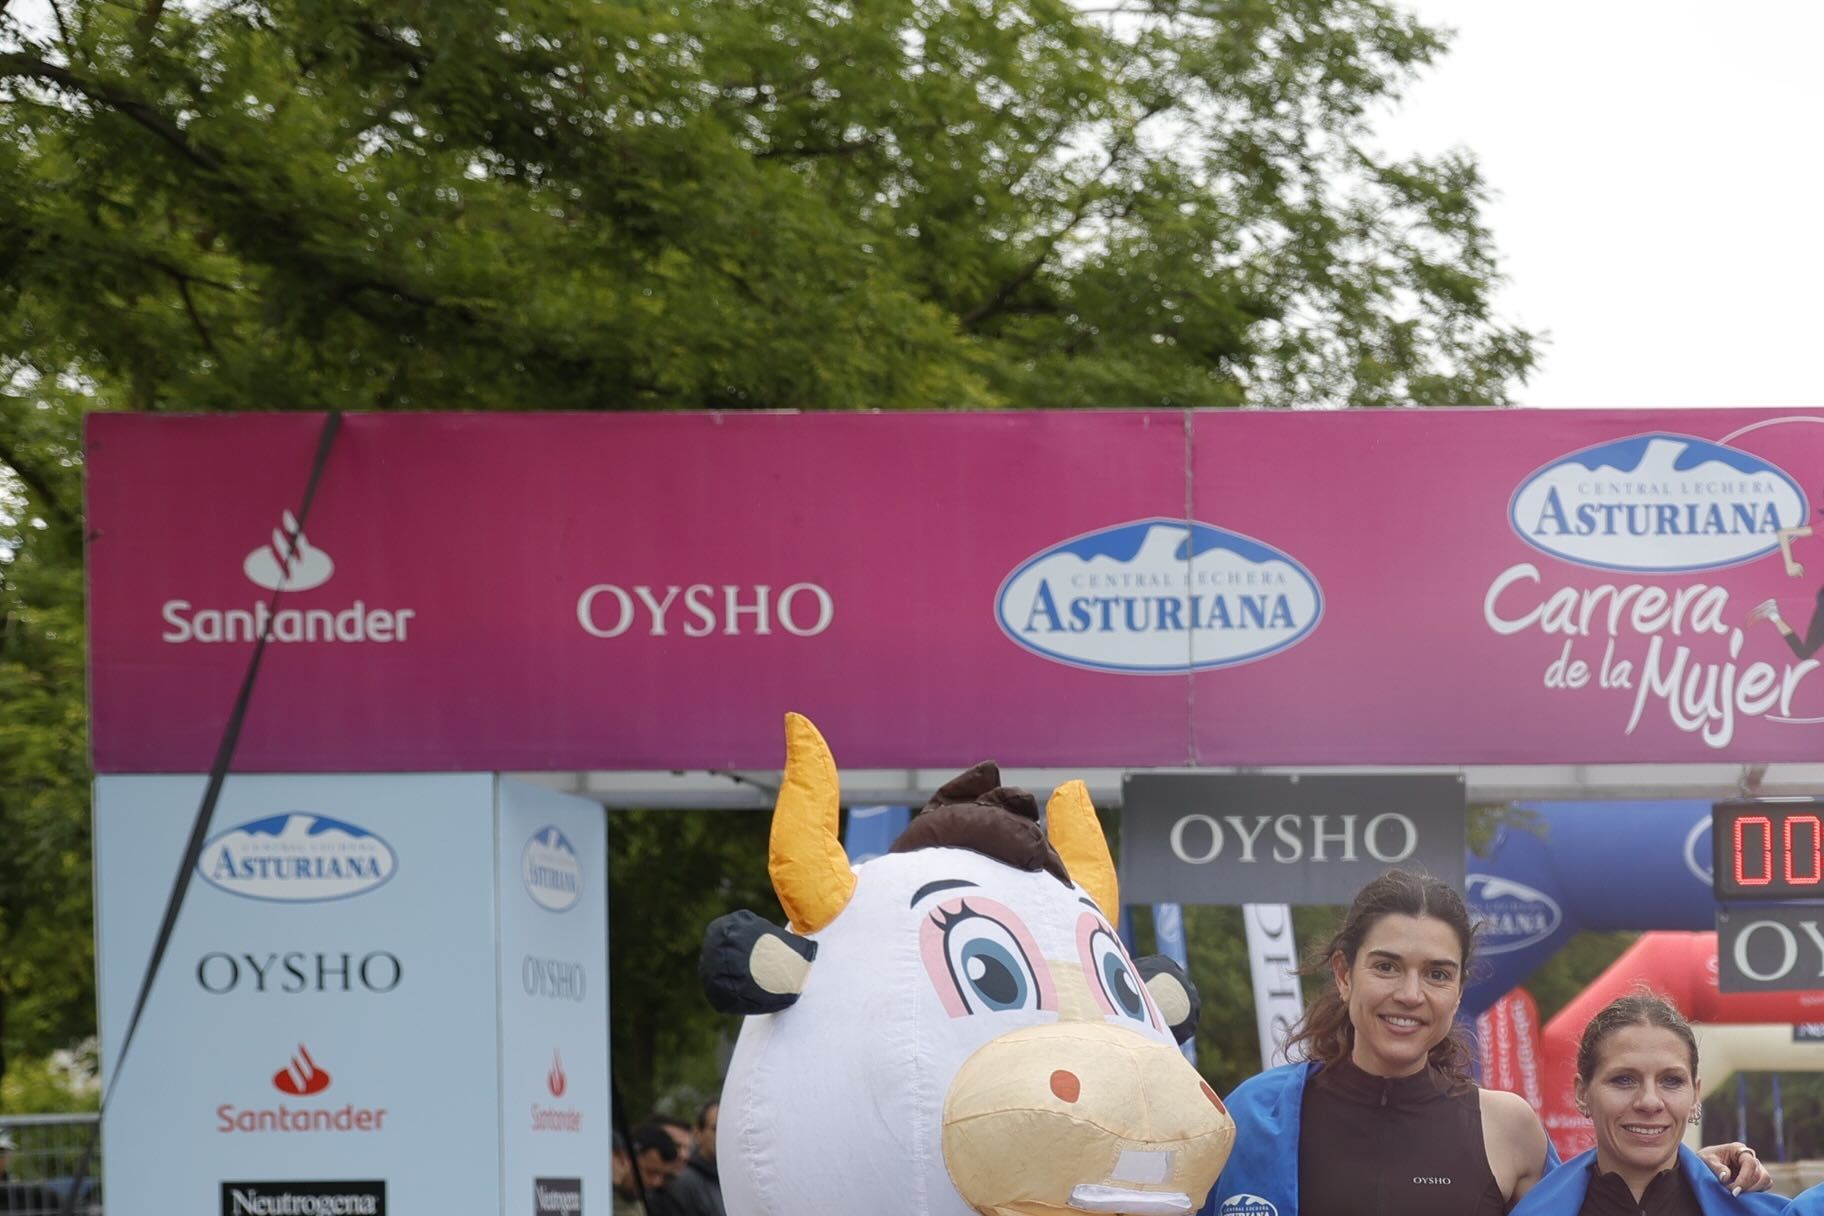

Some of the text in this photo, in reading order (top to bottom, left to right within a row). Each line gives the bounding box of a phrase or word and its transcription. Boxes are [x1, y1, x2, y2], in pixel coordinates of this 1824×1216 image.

[1531, 485, 1782, 536] ASTURIANA
[1578, 480, 1775, 496] CENTRAL LECHERA
[1071, 570, 1288, 588] CENTRAL LECHERA
[1483, 563, 1730, 636] Carrera
[161, 599, 416, 644] Santander
[576, 581, 835, 639] OYSHO
[1023, 577, 1298, 634] ASTURIANA
[1544, 627, 1822, 750] de la Mujer
[1169, 812, 1418, 865] OYSHO
[213, 845, 382, 881] ASTURIANA
[196, 950, 404, 995] OYSHO
[521, 954, 587, 1003] OYSHO
[217, 1103, 388, 1134] Santander
[1413, 1176, 1452, 1186] OYSHO
